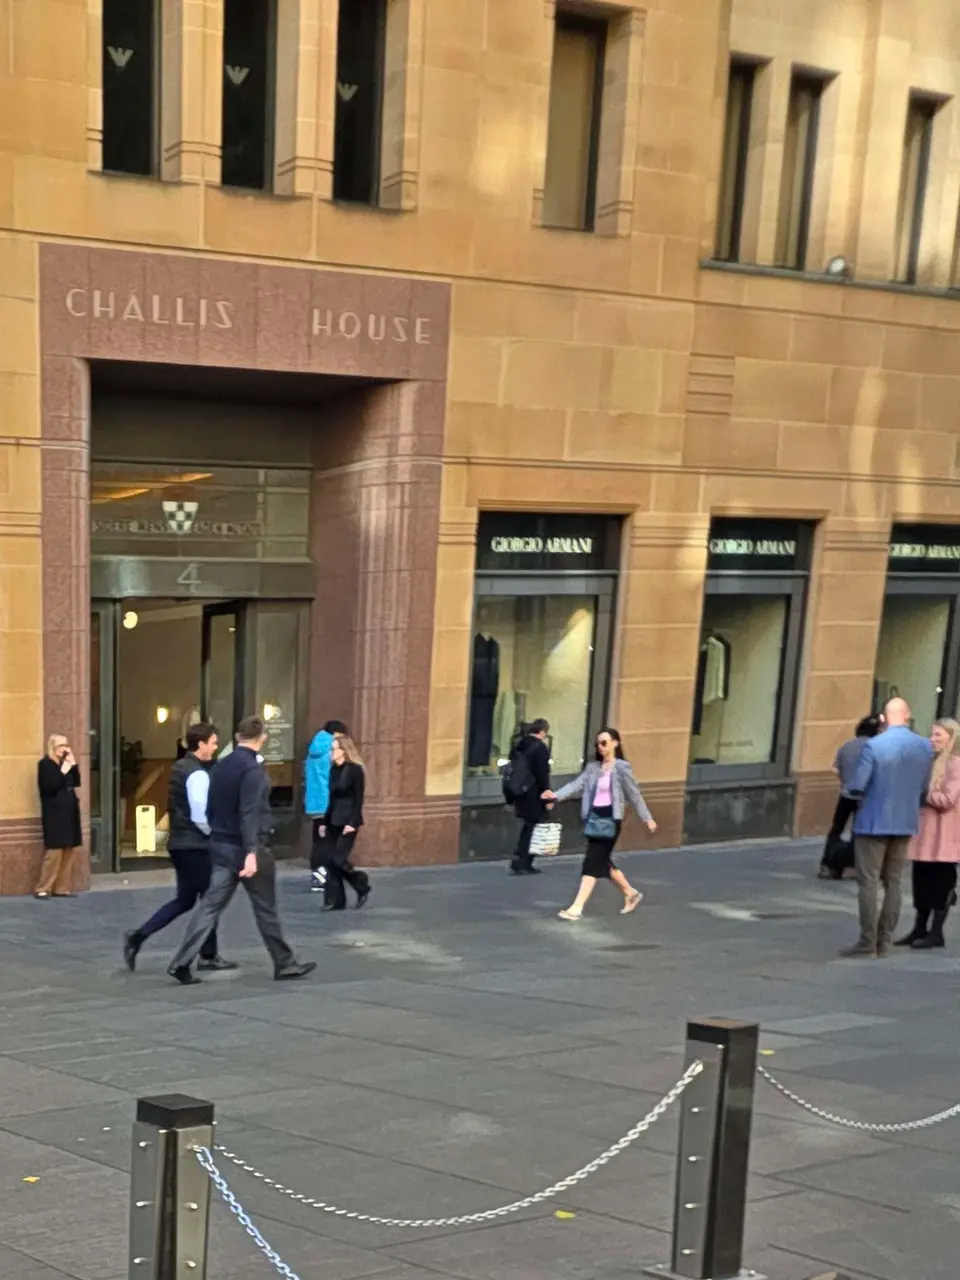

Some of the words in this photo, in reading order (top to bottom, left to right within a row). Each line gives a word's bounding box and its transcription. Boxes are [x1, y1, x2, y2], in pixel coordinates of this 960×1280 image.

[65, 288, 233, 329] CHALLIS
[312, 308, 432, 345] HOUSE
[544, 537, 592, 553] ARMANI
[176, 562, 202, 594] 4
